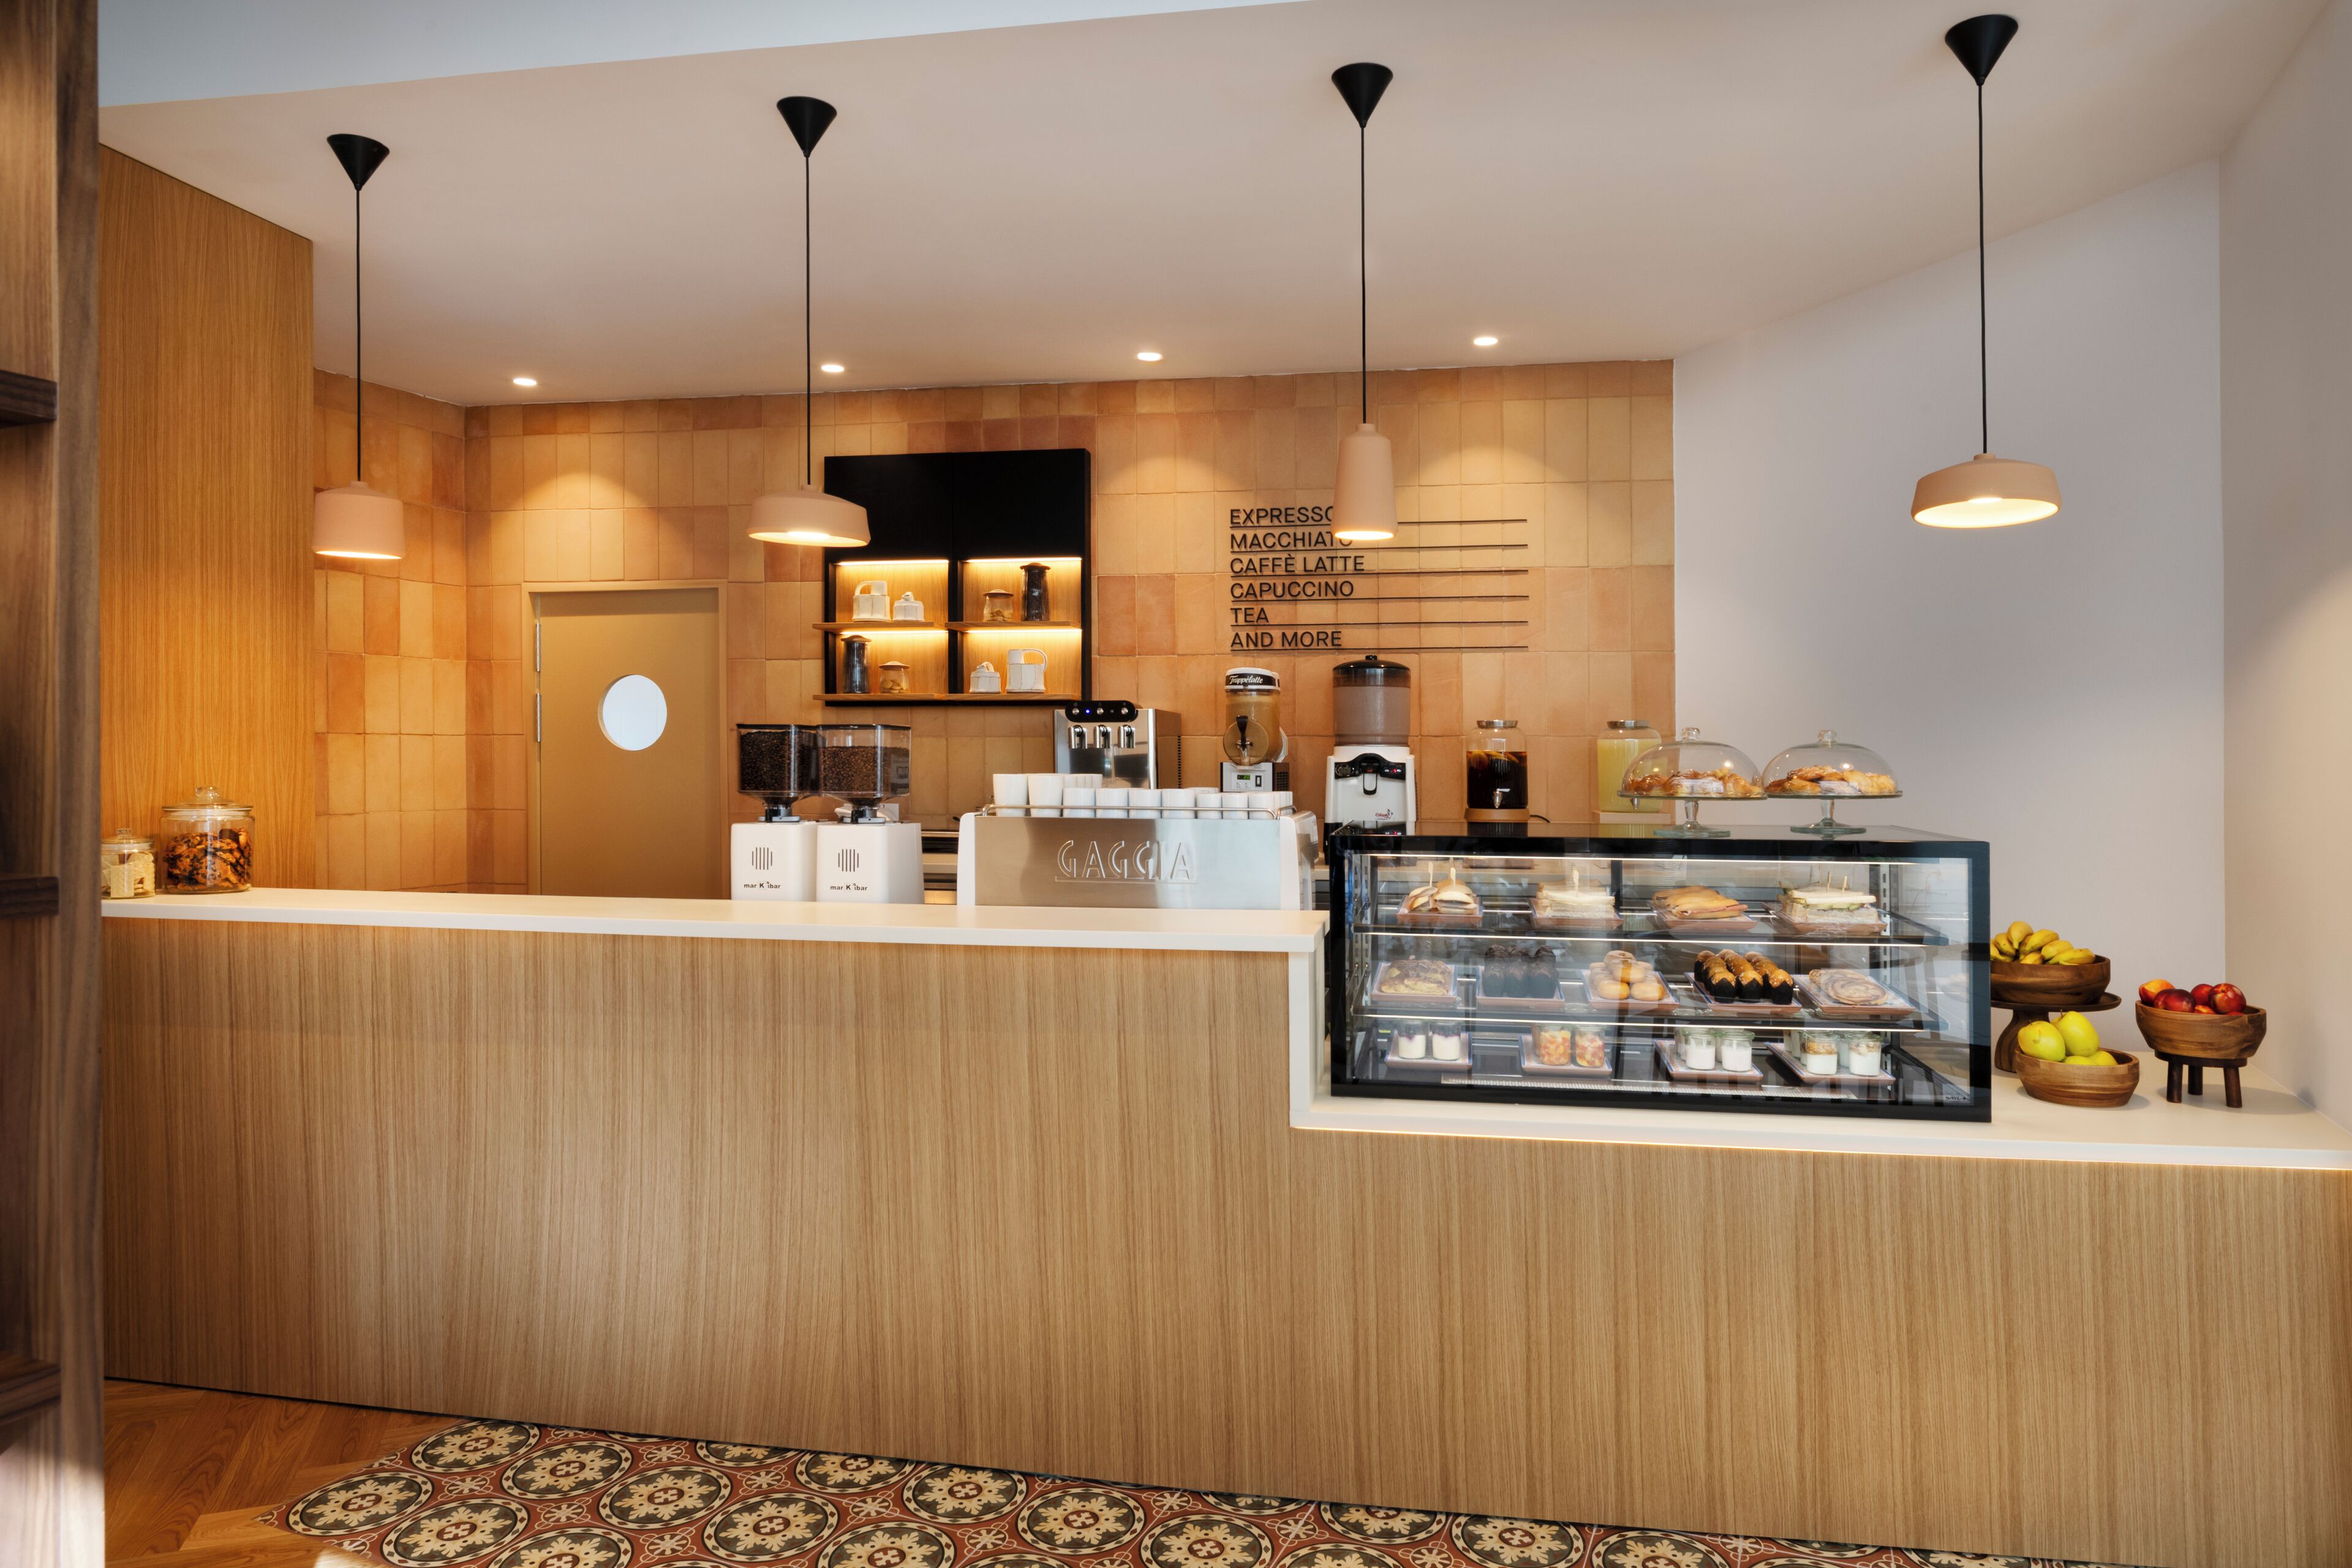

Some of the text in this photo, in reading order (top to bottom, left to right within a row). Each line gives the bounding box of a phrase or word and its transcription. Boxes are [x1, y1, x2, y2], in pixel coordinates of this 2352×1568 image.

[1230, 553, 1365, 574] CAFFÈ LATTE
[1230, 580, 1354, 599] CAPUCCINO
[1229, 607, 1270, 624] TEA
[1230, 630, 1342, 648] AND MORE
[1057, 839, 1197, 881] GAGGIA
